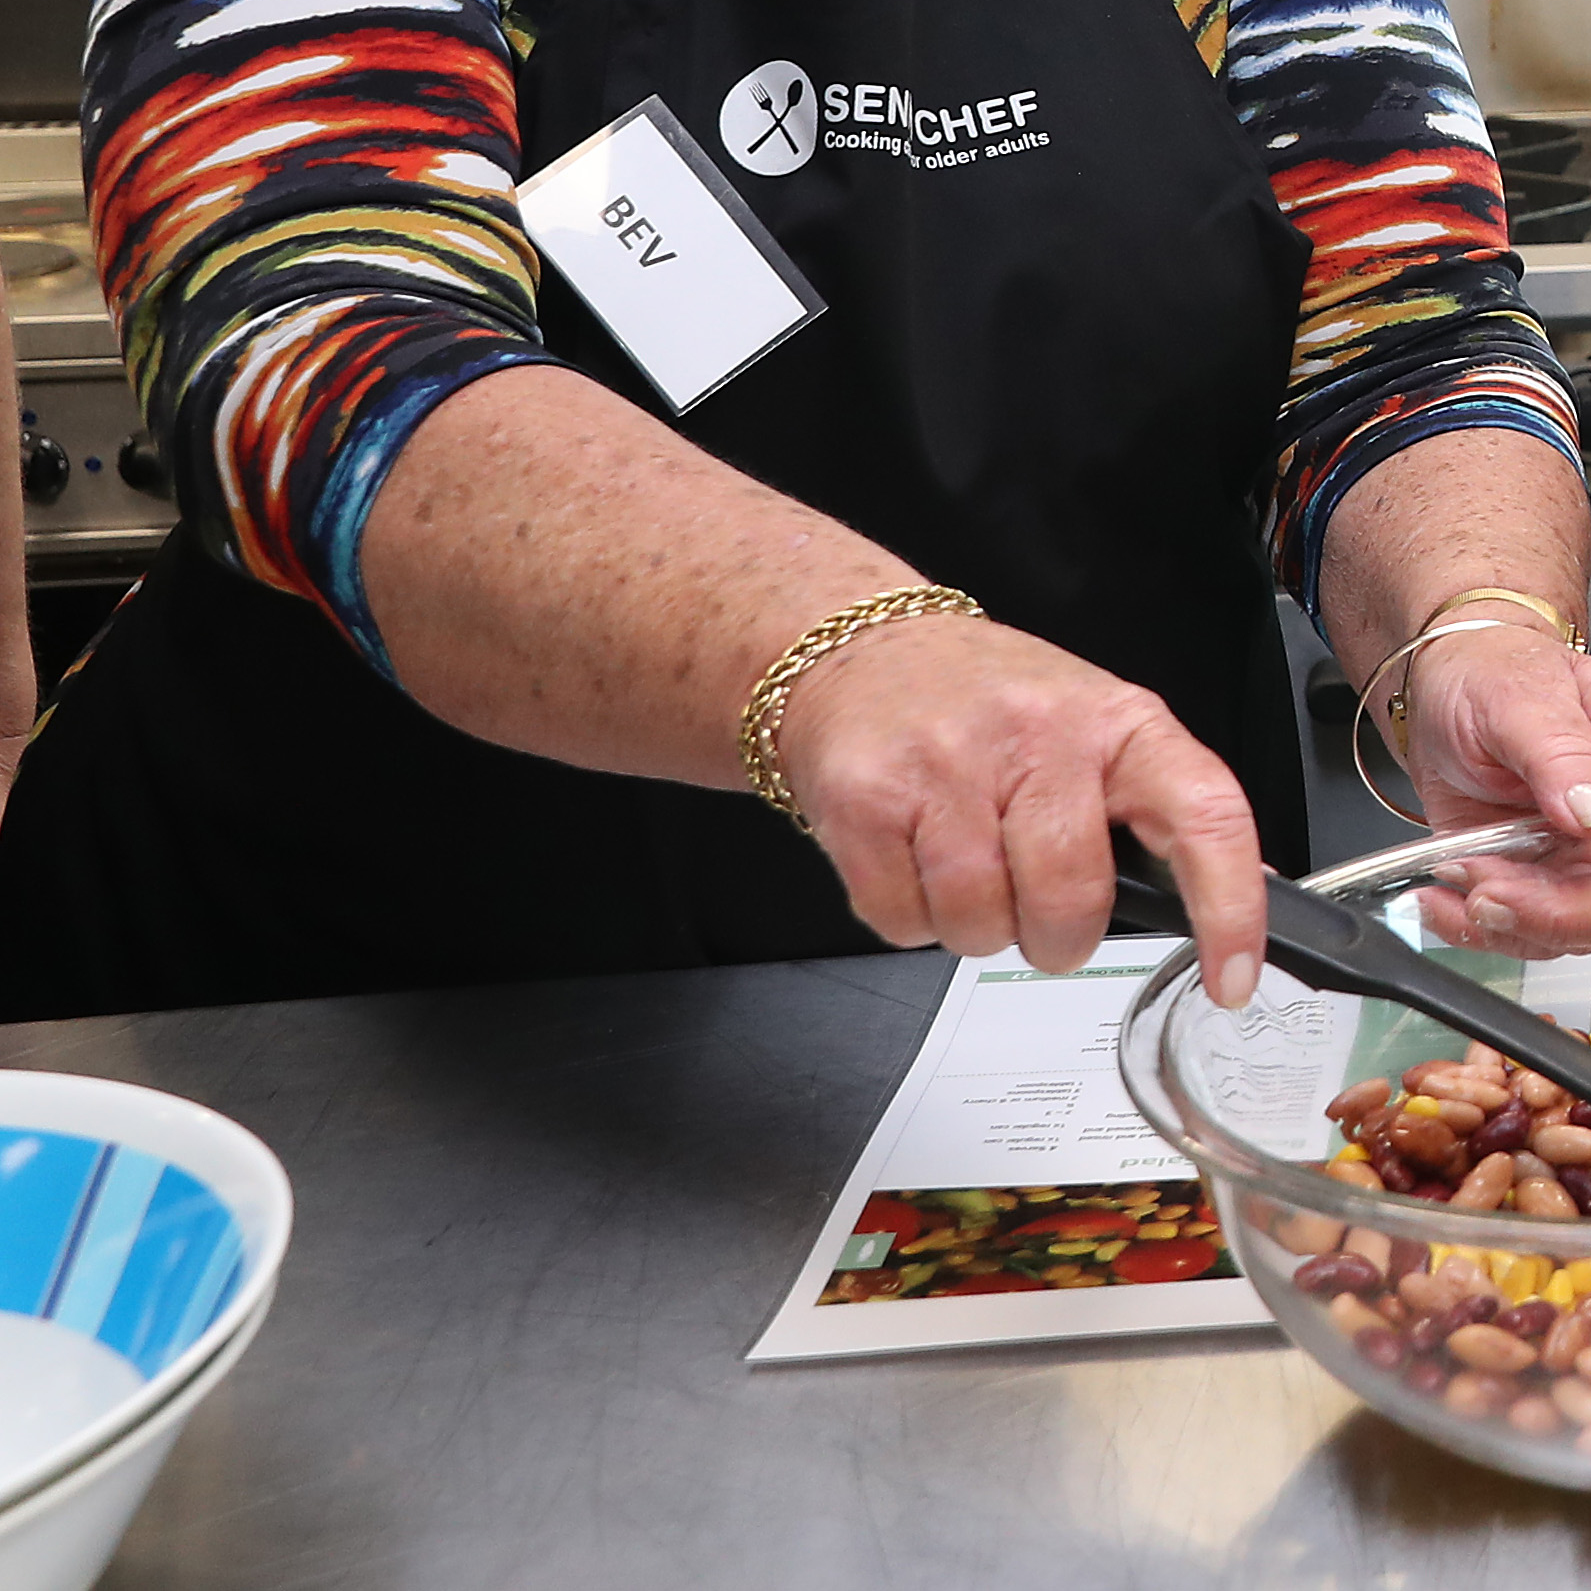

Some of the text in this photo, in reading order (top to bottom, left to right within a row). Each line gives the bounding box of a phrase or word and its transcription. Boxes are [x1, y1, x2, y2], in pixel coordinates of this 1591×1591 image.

[914, 90, 1038, 146] CHEF
[824, 130, 902, 157] Cooking
[924, 148, 978, 169] older
[985, 131, 1051, 158] adults
[598, 193, 678, 270] BEV
